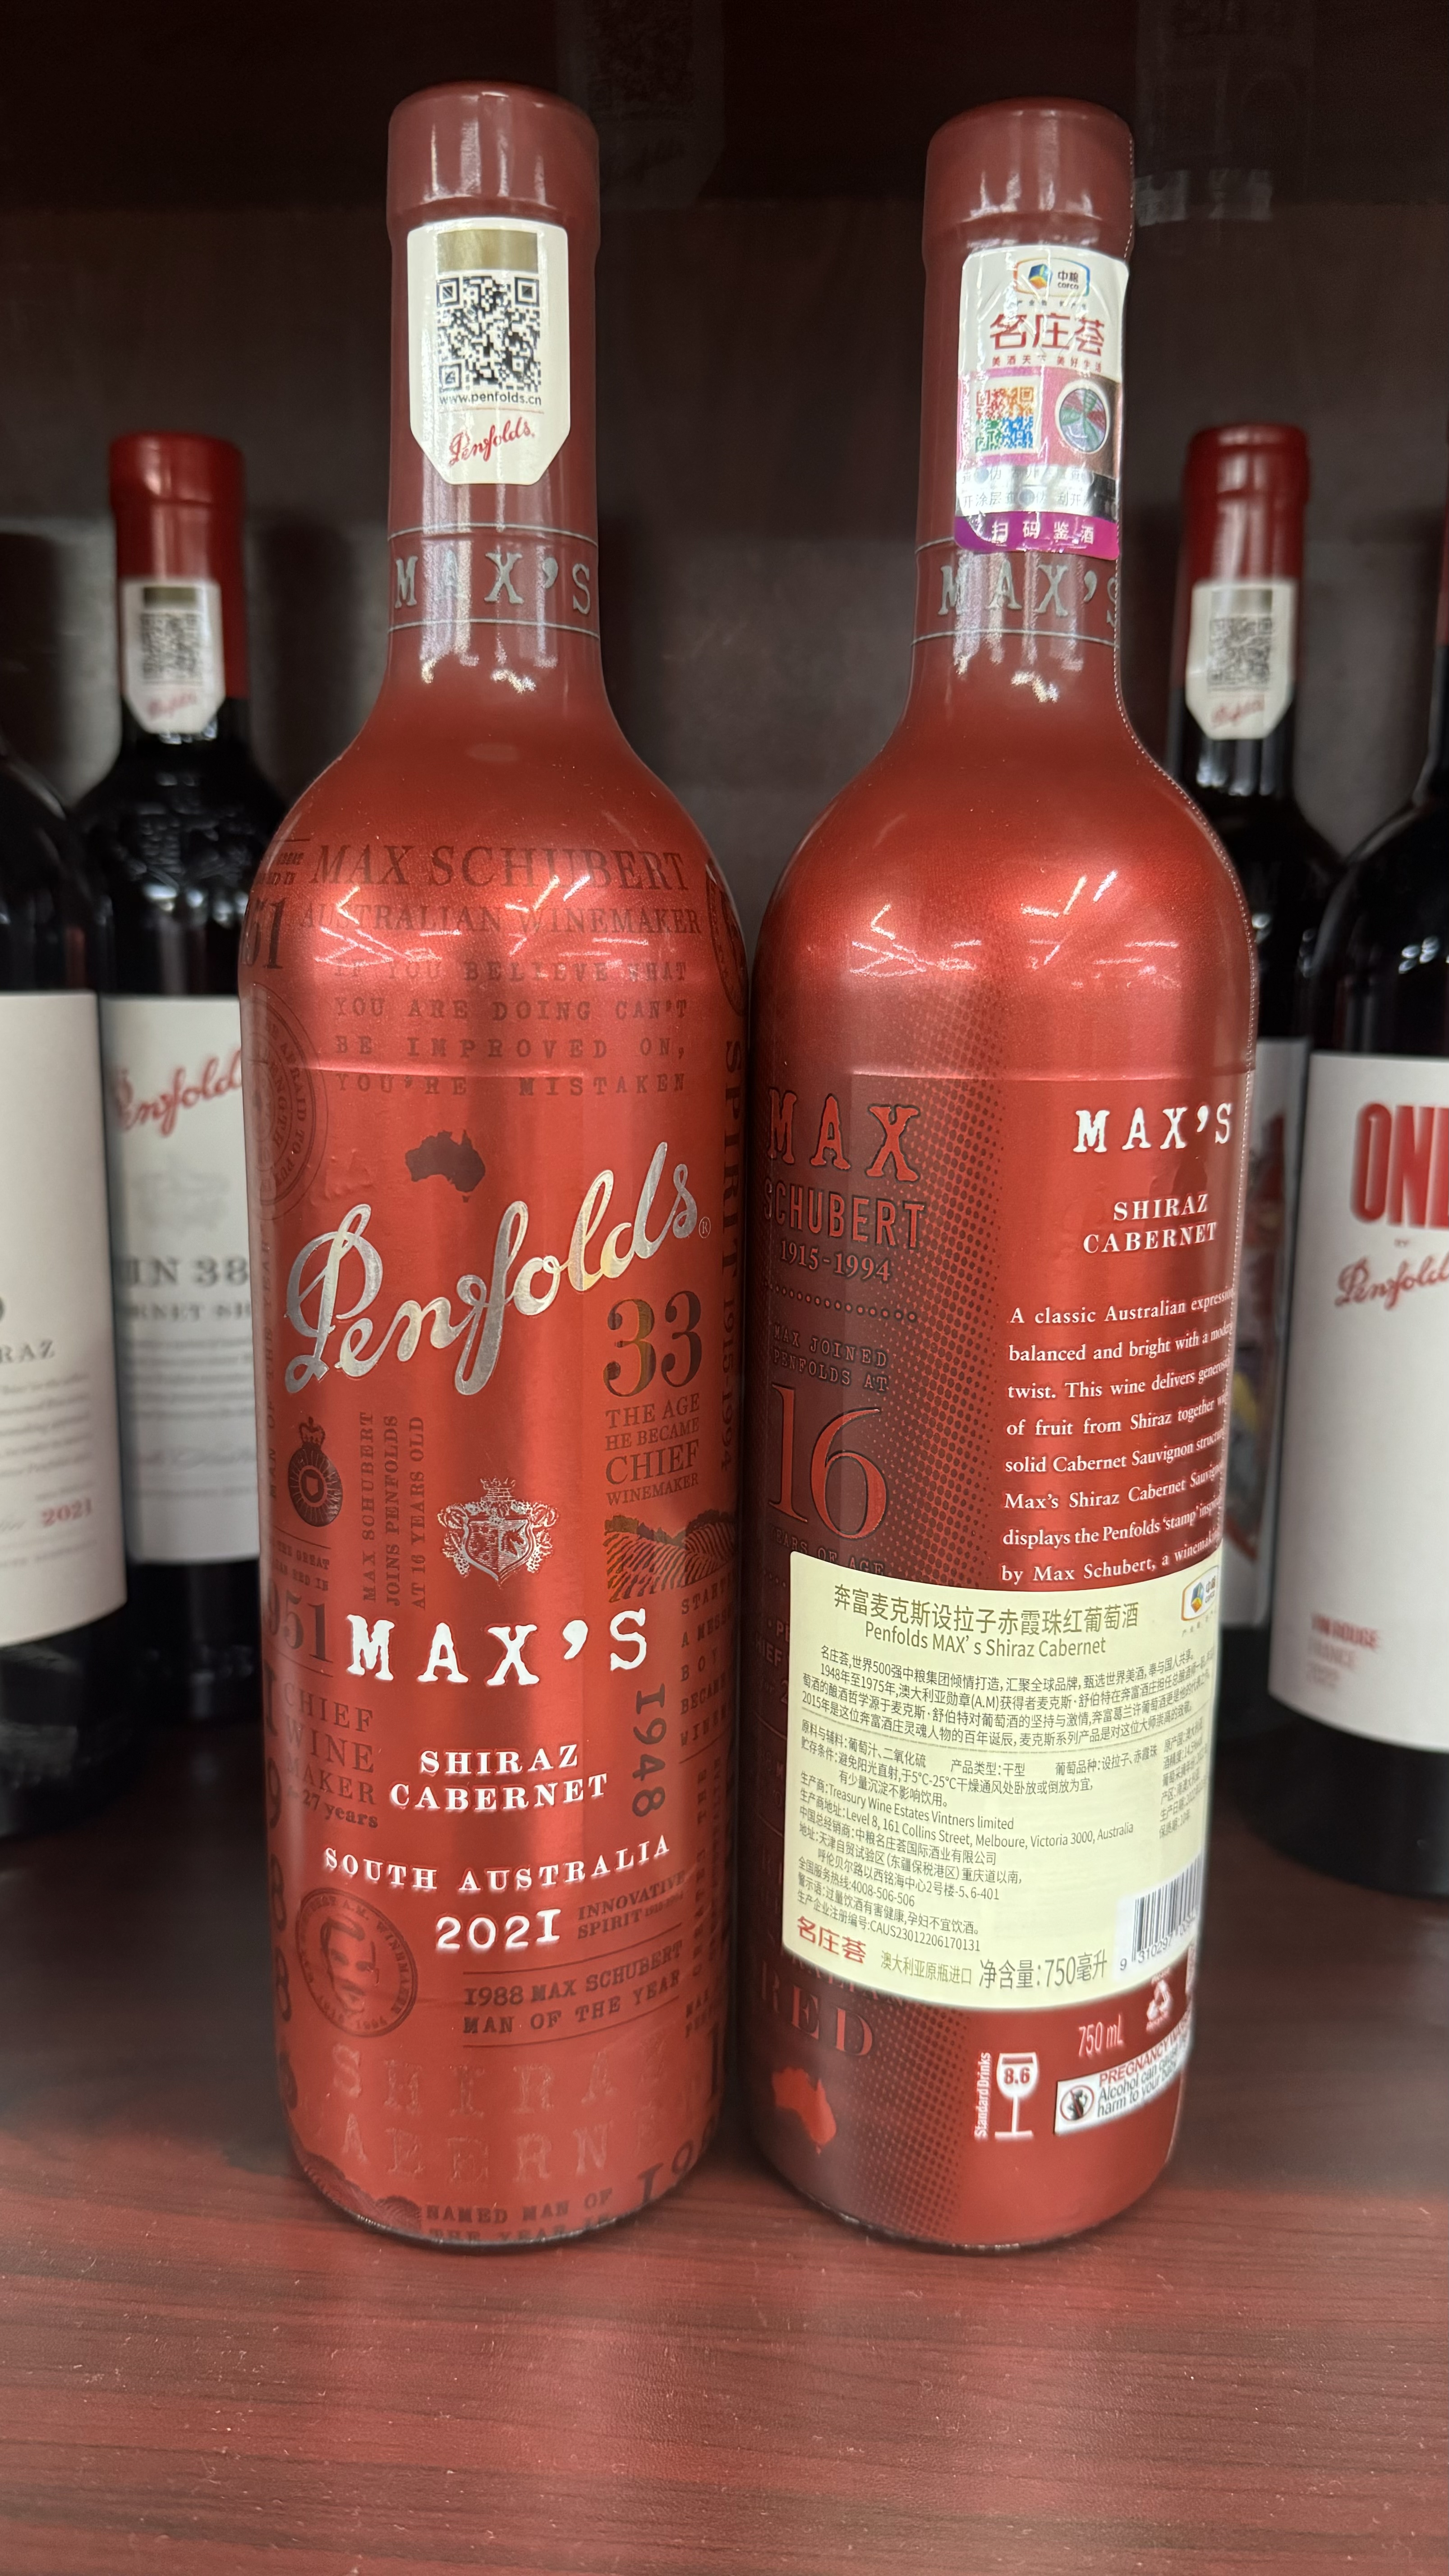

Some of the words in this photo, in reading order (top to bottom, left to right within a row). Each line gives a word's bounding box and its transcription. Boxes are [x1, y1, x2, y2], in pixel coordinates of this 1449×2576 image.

[989, 312, 1105, 357] 名庄荟
[439, 390, 542, 405] www.penfolds.cn
[448, 418, 532, 466] Penfolds
[991, 520, 1094, 545] 扫码鉴酒
[395, 552, 591, 614] MAX'S
[308, 844, 418, 885] MAX
[427, 846, 690, 891] SCHUBERT
[519, 906, 702, 934] WINEMAKER
[464, 961, 608, 982] BELIEVE
[336, 997, 385, 1019] YOU
[408, 998, 469, 1020] ARE
[492, 999, 592, 1021] DOING
[614, 998, 687, 1020] CAN'T
[335, 1034, 373, 1056] BE
[407, 1036, 607, 1059] IMPROVED
[639, 1036, 685, 1060] ON,
[335, 1073, 468, 1097] YOU'RE
[517, 1072, 686, 1096] MISTAKEN
[767, 1088, 921, 1182] MAX
[1072, 1102, 1232, 1153] MAX'S
[722, 1040, 742, 1279] SPIRIT
[764, 1177, 926, 1250] SCHUBERT
[1113, 1193, 1209, 1221] SHIRAZ
[1082, 1222, 1217, 1254] CABERNET
[284, 1141, 697, 1396] Penfolds
[780, 1239, 892, 1283] 1915-1994
[1334, 1251, 1449, 1311] Penfold
[1009, 1307, 1025, 1324] A
[1035, 1306, 1096, 1324] classic
[1104, 1300, 1186, 1322] Australian
[602, 1290, 702, 1398] 33
[773, 1324, 800, 1348] MAX
[810, 1337, 888, 1367] JOINED
[1008, 1344, 1086, 1362] balanced
[1093, 1342, 1123, 1360] and
[1128, 1337, 1171, 1359] bright
[1174, 1330, 1200, 1351] with
[1202, 1334, 1208, 1344] a
[773, 1348, 851, 1386] PENFOLDS
[864, 1374, 890, 1393] AT
[1007, 1382, 1056, 1399] twist.
[1064, 1381, 1102, 1398] This
[1110, 1379, 1146, 1396] wine
[1150, 1371, 1195, 1391] delivers
[605, 1403, 656, 1430] THE
[661, 1392, 700, 1421] AGE
[1006, 1419, 1026, 1435] of
[1035, 1419, 1073, 1435] fruit
[1083, 1417, 1122, 1434] from
[1130, 1412, 1172, 1431] Shiraz
[1177, 1398, 1215, 1424] together
[409, 1417, 425, 1462] OLD
[605, 1432, 631, 1452] HE
[636, 1417, 699, 1446] BECAME
[360, 1412, 375, 1541] SCHUBERT
[383, 1415, 400, 1536] PENFOLDS
[605, 1439, 699, 1485] CHIEF
[768, 1383, 887, 1540] 16
[1005, 1456, 1046, 1472] solid
[1053, 1454, 1127, 1472] Cabernet
[1132, 1441, 1194, 1466] Sauvignon
[409, 1471, 425, 1545] YEARS
[605, 1472, 699, 1506] WINEMAKER
[1003, 1493, 1059, 1509] Max's
[1069, 1491, 1120, 1509] Shiraz
[1127, 1479, 1186, 1503] Cabernet
[42, 1498, 93, 1527] 2021
[1003, 1528, 1071, 1550] displays
[1074, 1527, 1099, 1544] the
[1102, 1518, 1160, 1542] Penfolds
[296, 1549, 331, 1570] GREAT
[363, 1551, 376, 1603] MAX
[386, 1543, 400, 1606] JOINS
[411, 1554, 426, 1574] 16
[848, 1557, 885, 1575] AGE
[1001, 1564, 1024, 1585] by
[1033, 1565, 1076, 1581] Max
[1083, 1557, 1156, 1580] Schubert,
[1161, 1554, 1169, 1567] a
[412, 1582, 426, 1610] AT
[834, 1583, 1139, 1636] 奔富麦克斯设拉子赤霞珠红葡萄酒
[345, 1607, 648, 1687] MAX'S
[865, 1620, 928, 1649] Penfolds
[986, 1637, 1035, 1657] Shiraz
[1039, 1637, 1106, 1657] Cabernet
[681, 1647, 718, 1682] BOY
[284, 1682, 373, 1733] CHIEF
[286, 1716, 374, 1774] WINE
[419, 1743, 578, 1777] SHIRAZ
[632, 1682, 667, 1817] 1948
[287, 1753, 376, 1805] MAKER
[950, 1758, 1026, 1777] 产品类型:干型
[390, 1772, 608, 1812] CABERNET
[838, 1769, 948, 1808] 有少量沉淀不影响饮用。
[325, 1803, 378, 1829] years
[868, 1796, 892, 1813] Wine
[894, 1803, 929, 1822] Estates
[931, 1810, 975, 1828] Vintners
[977, 1815, 1015, 1830] limited
[871, 1815, 881, 1831] 8,
[883, 1818, 899, 1834] 161
[902, 1822, 937, 1840] Collins
[938, 1829, 973, 1848] Street,
[975, 1833, 1028, 1849] Melboure,
[1030, 1835, 1068, 1848] Victoria
[1070, 1830, 1096, 1845] 3000,
[1097, 1822, 1134, 1841] Australia
[323, 1847, 438, 1891] SOUTH
[458, 1834, 670, 1892] AUSTRALIA
[798, 1856, 915, 1907] 全国服务热线:4008-506-506
[577, 1870, 686, 1921] INNOVATIVE
[435, 1908, 562, 1952] 2021
[577, 1908, 643, 1940] SPIRIT
[797, 1916, 867, 1964] 名庄荟
[463, 1986, 524, 2006] 1988
[529, 1975, 577, 2004] MAX
[585, 1940, 683, 1992] SCHUBERT
[880, 1950, 972, 1985] 澳大利亚原瓶进口
[979, 1949, 1108, 1990] 净含量:750毫升
[463, 2016, 513, 2035] MAN
[530, 2010, 562, 2030] OF
[575, 1995, 621, 2023] THE
[632, 1969, 681, 2006] YEAR
[1078, 2021, 1104, 2057] 750
[1106, 2014, 1124, 2049] mL
[976, 2052, 992, 2087] Drinks
[1004, 2066, 1030, 2084] 8.6
[1098, 2072, 1140, 2104] Alcohol
[1141, 2063, 1158, 2084] can
[1099, 2038, 1170, 2088] PREGNANCY
[974, 2088, 989, 2138] Standard
[1097, 2096, 1127, 2119] harm
[1129, 2088, 1140, 2105] to
[1141, 2074, 1160, 2098] your
[425, 2203, 507, 2224] NAMED
[523, 2199, 570, 2222] MAN
[584, 2188, 612, 2208] OF
